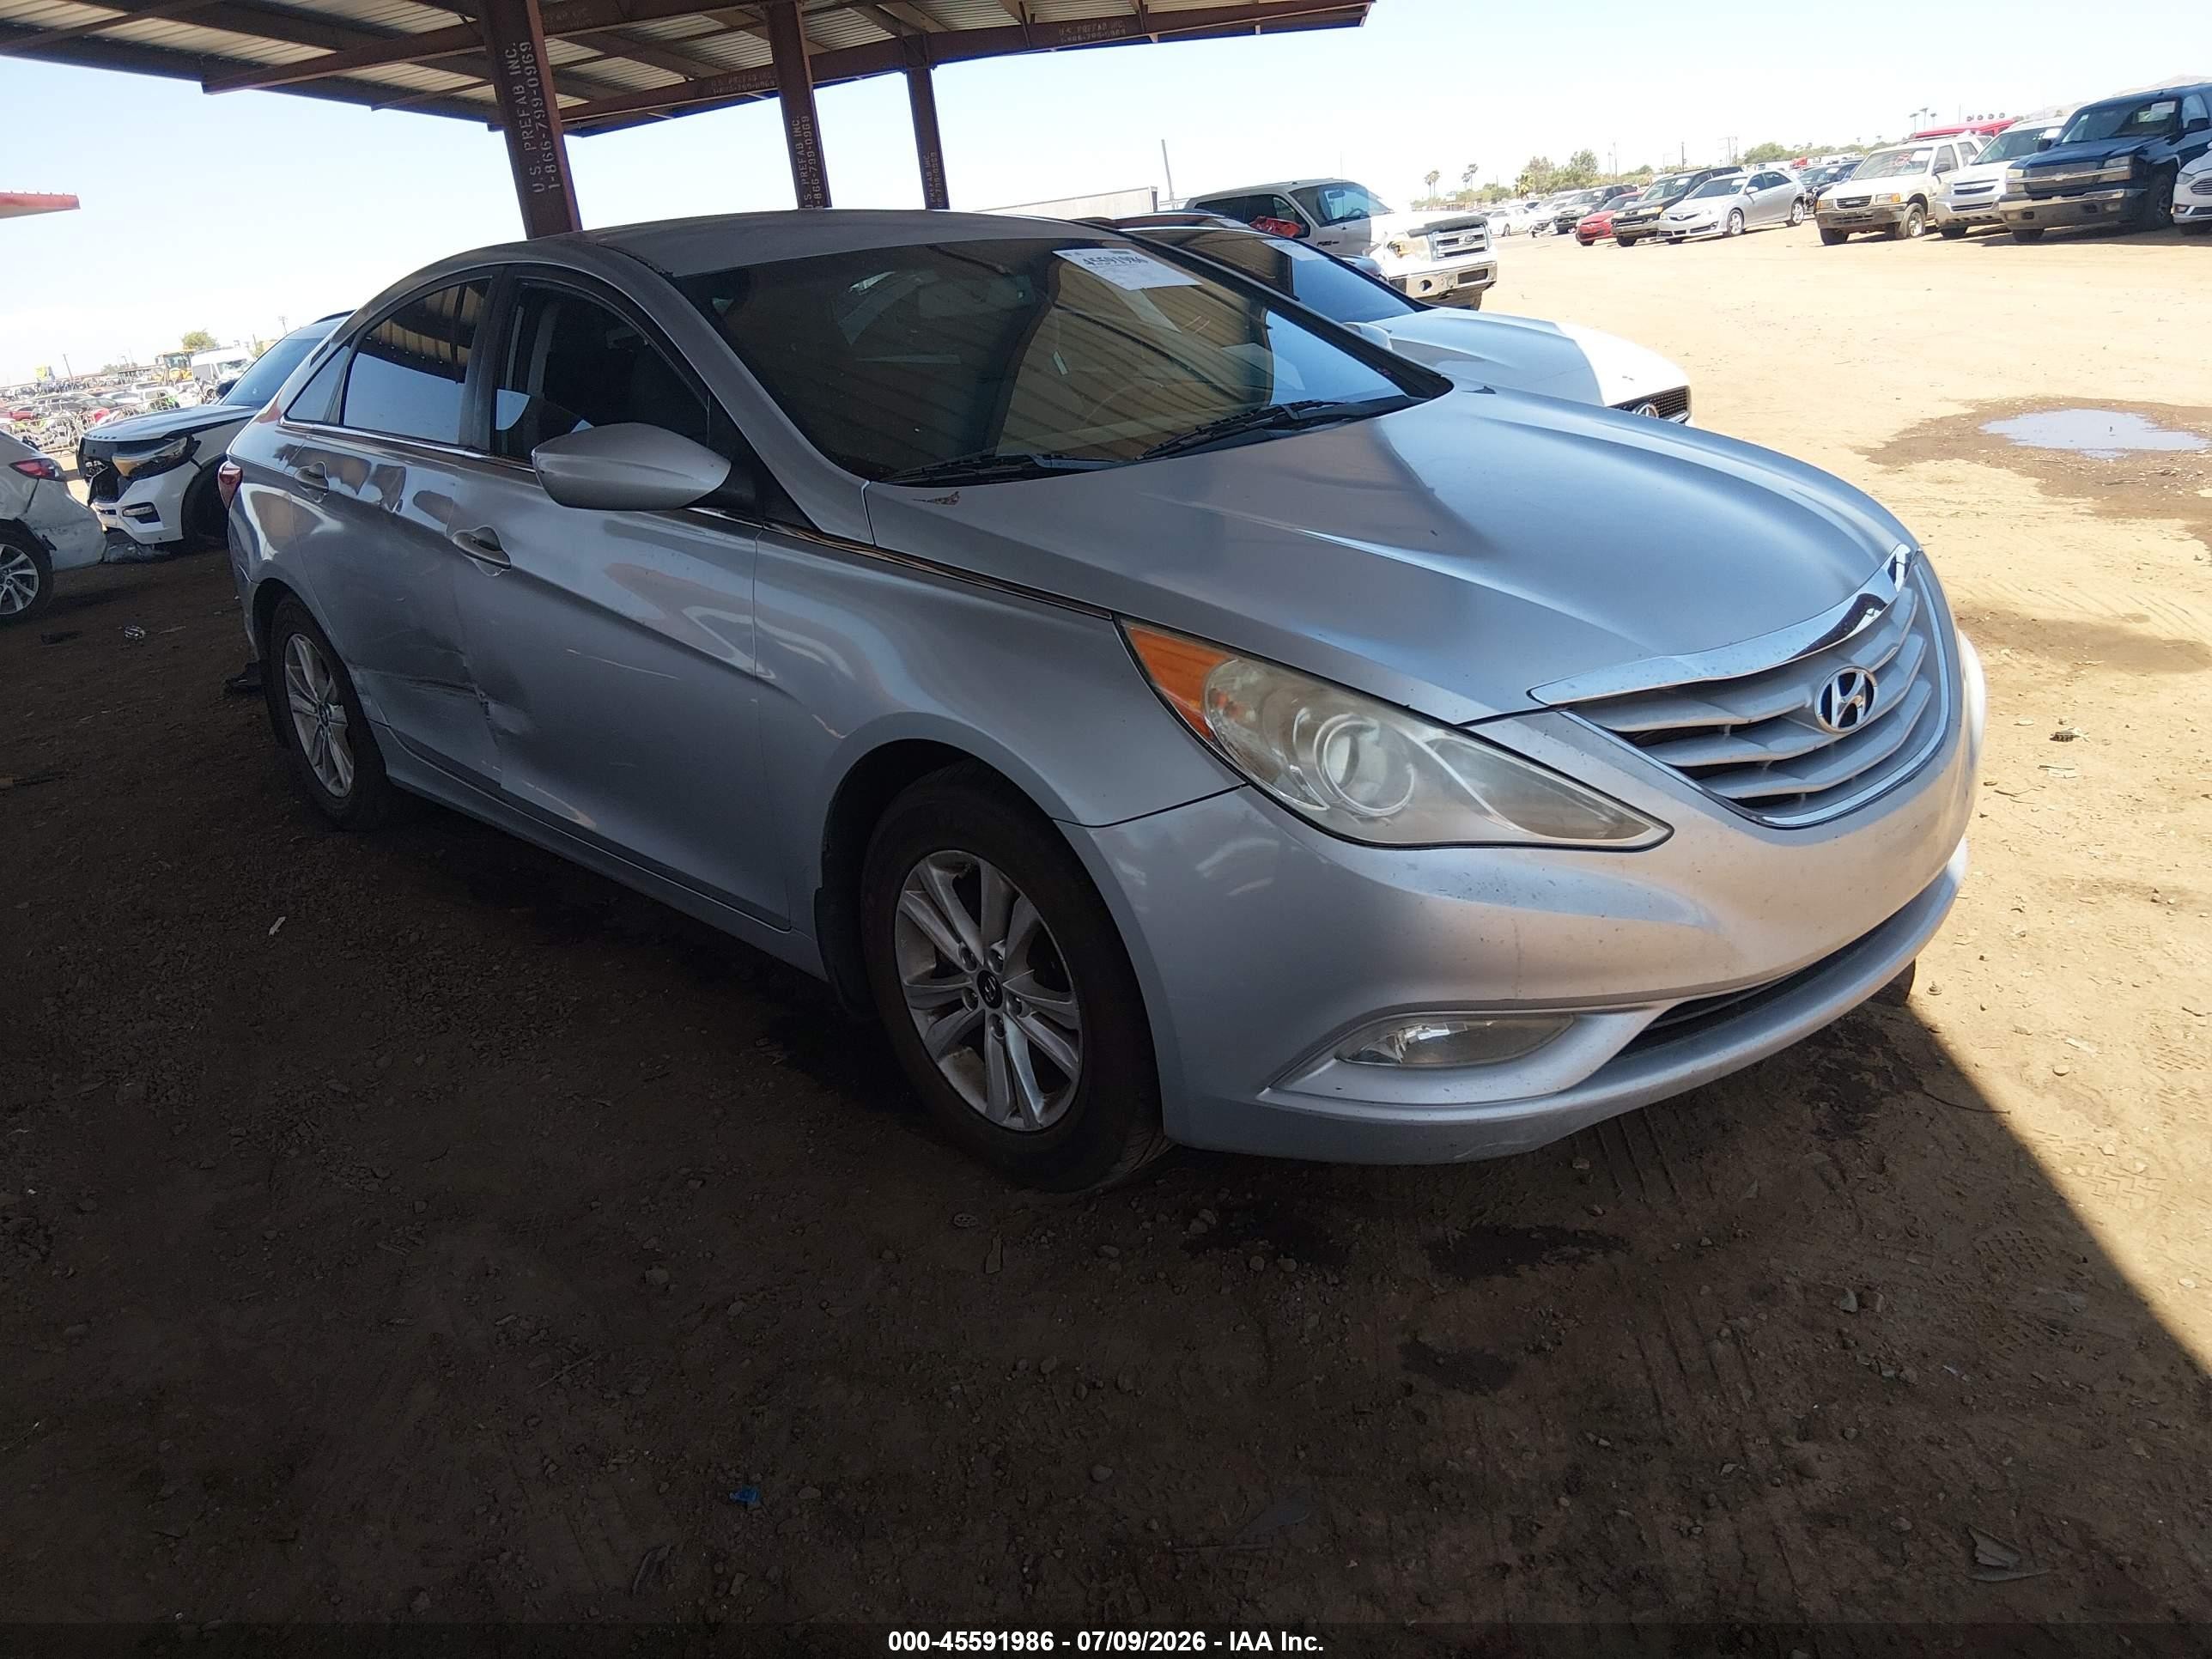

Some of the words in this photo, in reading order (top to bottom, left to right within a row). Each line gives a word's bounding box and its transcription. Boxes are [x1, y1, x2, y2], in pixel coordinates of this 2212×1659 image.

[505, 42, 522, 76] INC.
[513, 84, 537, 152] PREFAB
[519, 41, 562, 191] 1-866-799-0969
[792, 116, 802, 137] INC.
[530, 161, 545, 193] U.S.
[795, 143, 810, 185] PREFAB
